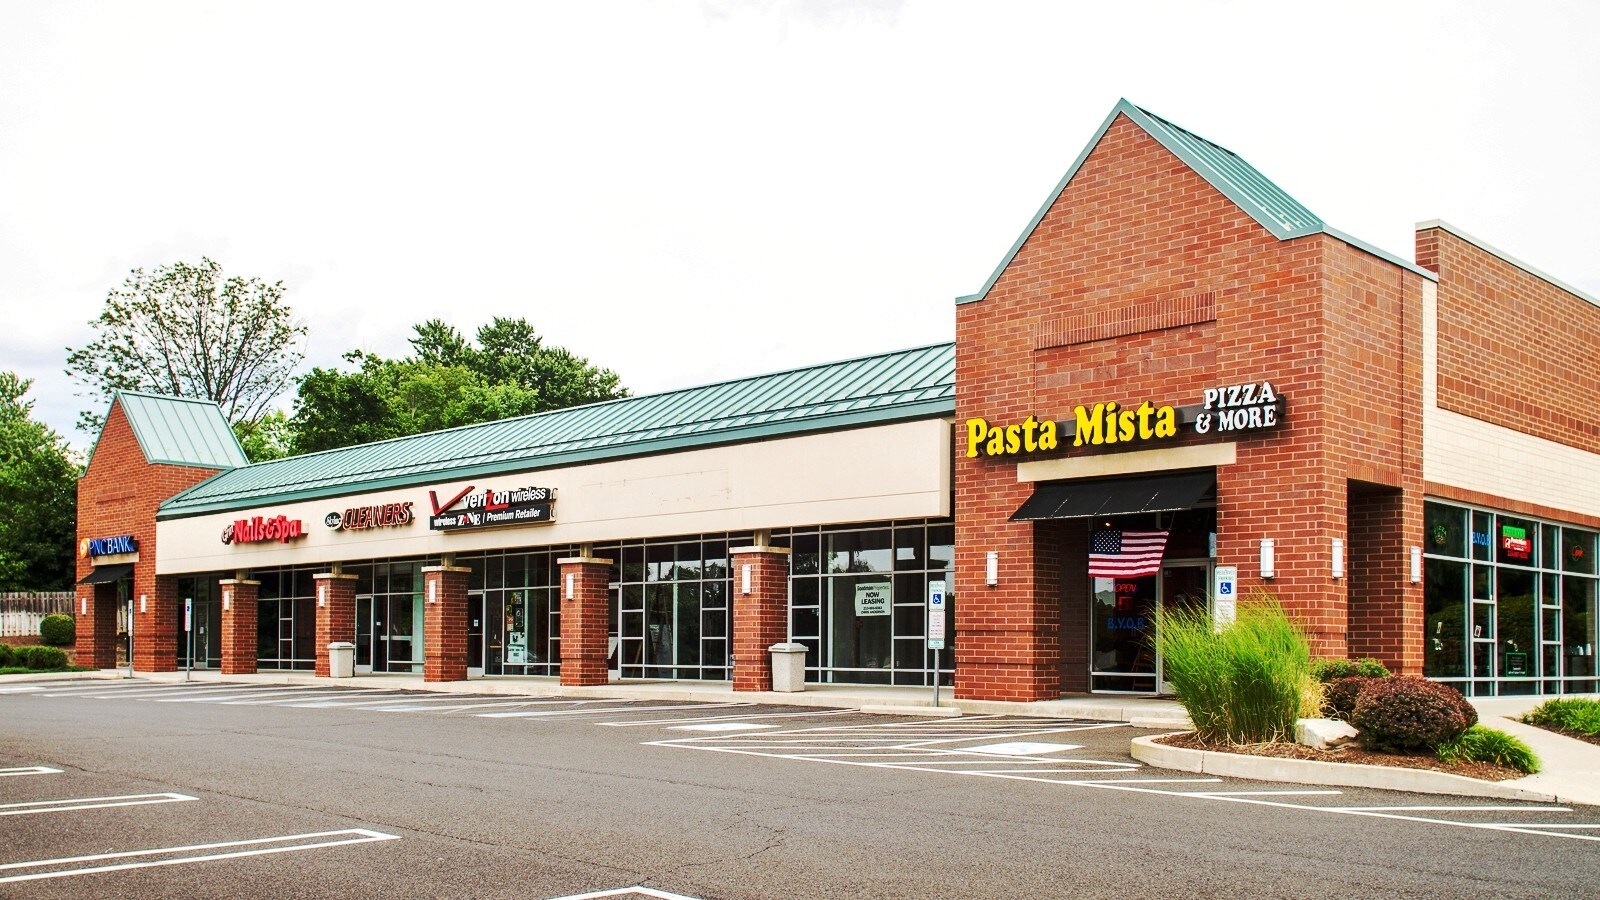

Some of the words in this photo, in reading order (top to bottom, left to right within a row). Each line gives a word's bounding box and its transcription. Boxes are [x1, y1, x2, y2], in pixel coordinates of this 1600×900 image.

[1203, 381, 1277, 410] PIZZA
[965, 415, 1058, 458] Pasta
[1073, 400, 1177, 447] Mista
[1195, 413, 1212, 434] &
[1217, 405, 1277, 432] MORE
[463, 488, 510, 511] verizon
[511, 487, 547, 503] wireless
[343, 502, 410, 530] CLEANERS
[433, 516, 457, 527] wireless
[486, 510, 515, 523] Premium
[515, 508, 541, 520] Retailer
[233, 516, 264, 543] Nails
[275, 515, 301, 544] Spa
[89, 539, 106, 556] PNC
[107, 535, 131, 554] BANK
[1114, 583, 1137, 593] OPEN
